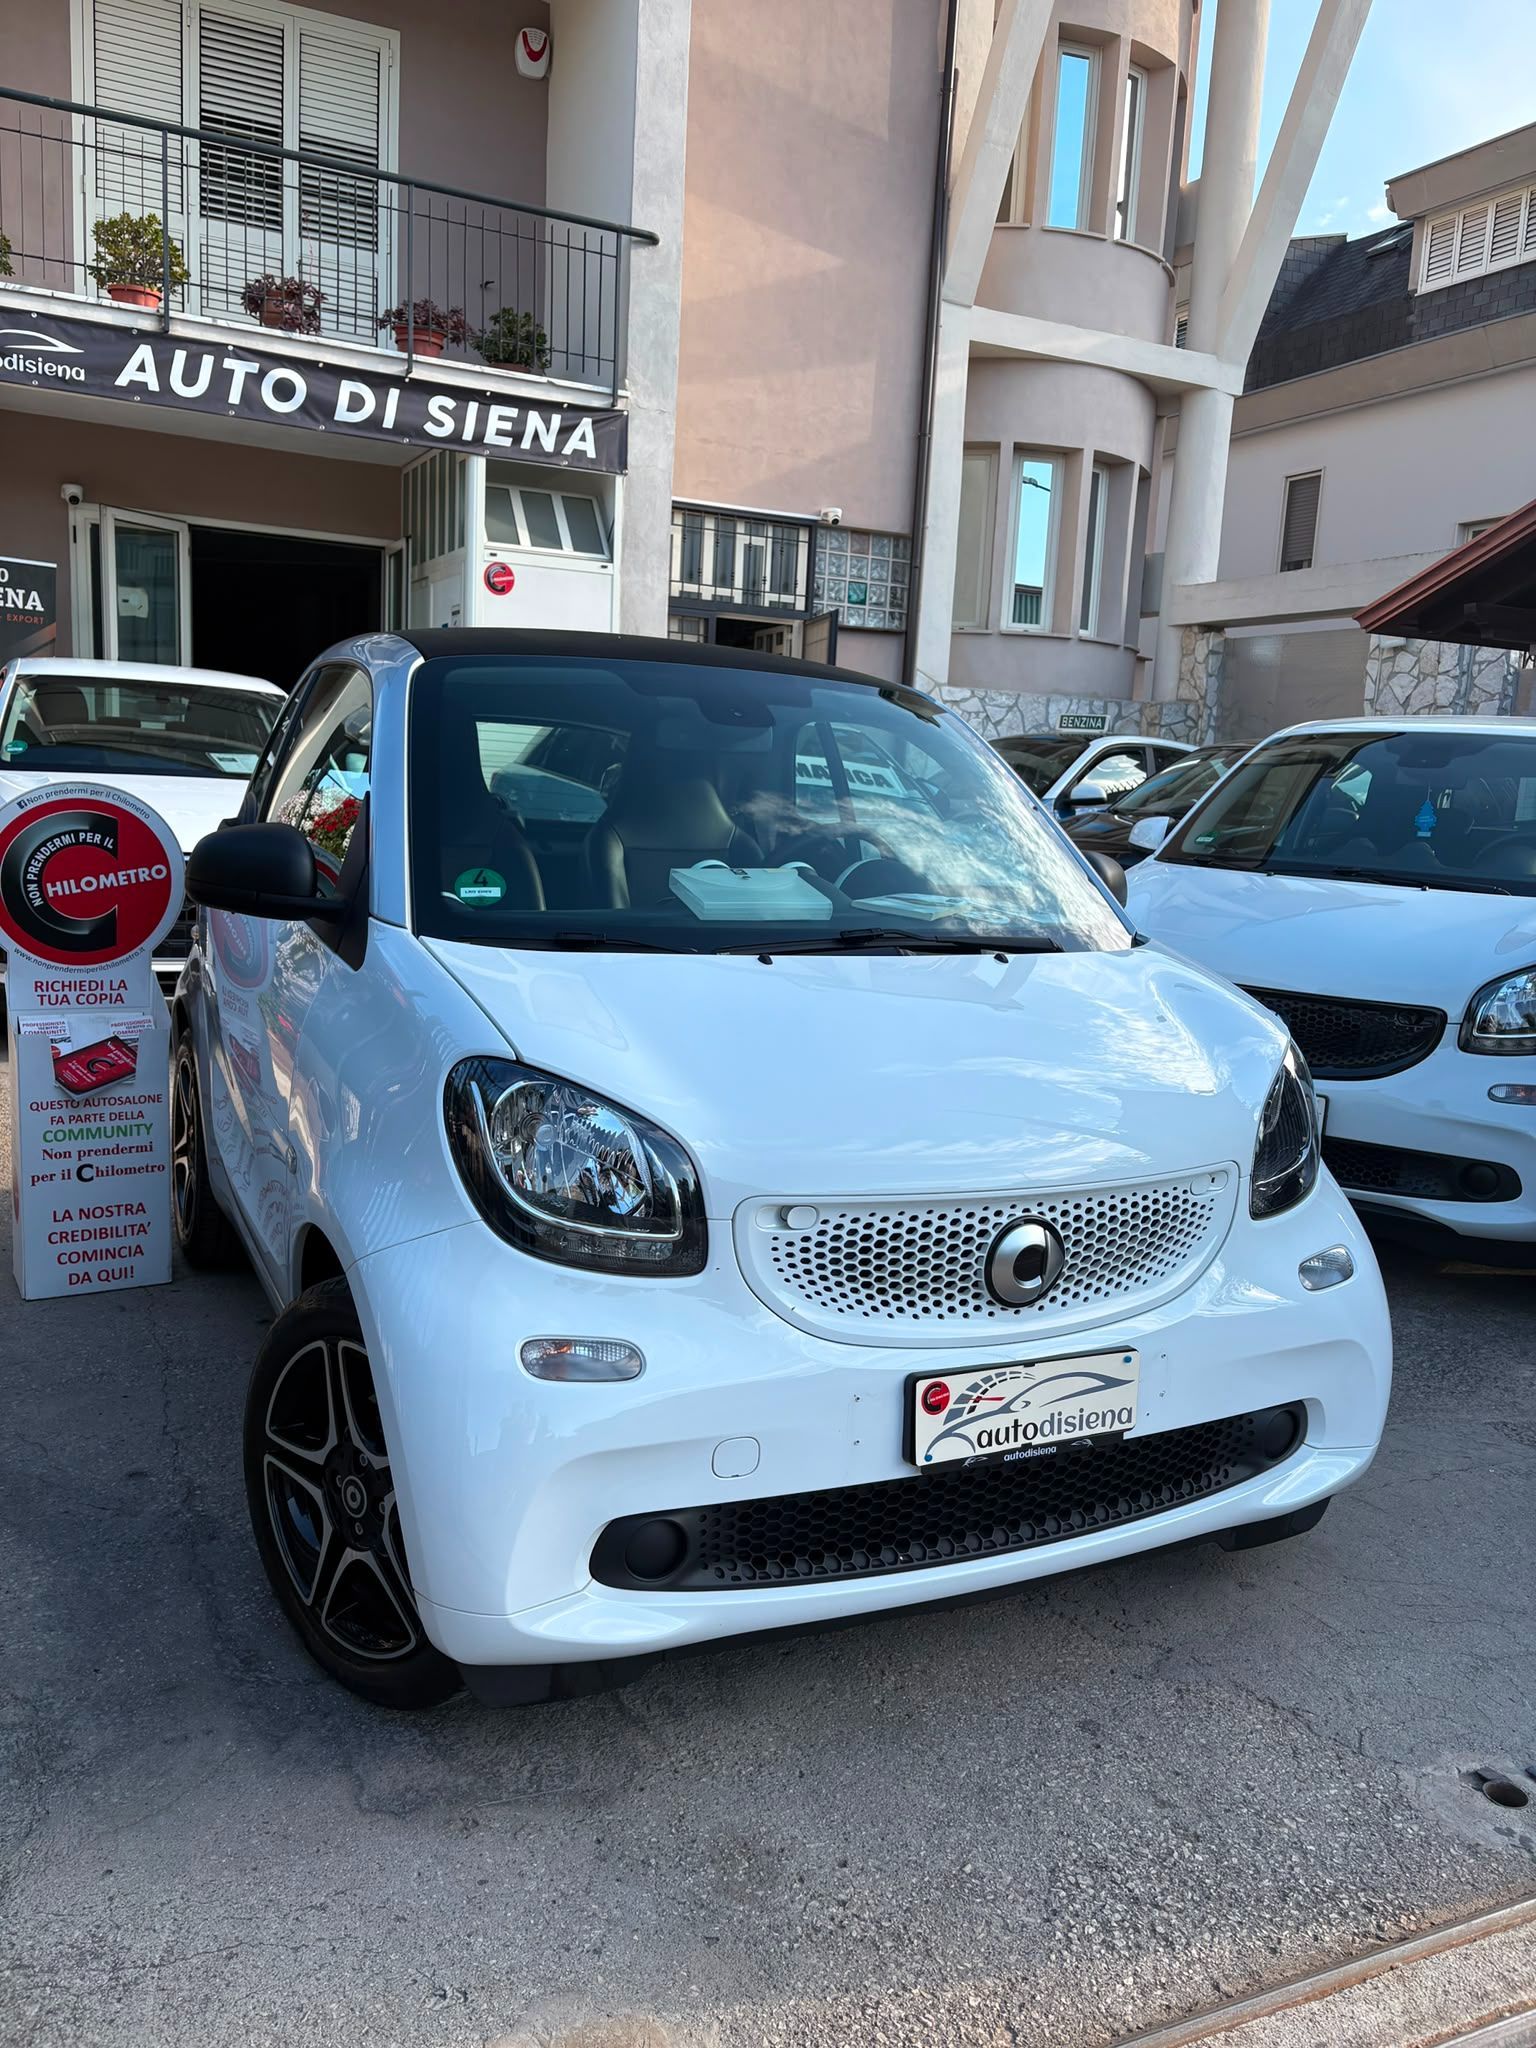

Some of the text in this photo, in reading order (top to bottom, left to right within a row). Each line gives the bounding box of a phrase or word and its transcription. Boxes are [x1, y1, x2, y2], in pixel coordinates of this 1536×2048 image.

[0, 353, 86, 382] disiena
[114, 344, 597, 459] AUTO DI SIENA
[6, 614, 44, 624] EXPORT
[1061, 716, 1102, 728] BENZINA
[27, 787, 151, 820] Non prendermi per il Chilometro
[27, 831, 114, 907] NON PRENDERMI PER IL
[473, 870, 488, 887] 4
[14, 946, 146, 975] www.nonprendermiperilchilometro.it
[34, 979, 128, 993] RICHIEDI LA
[37, 993, 125, 1006] TUA COPIA
[30, 1094, 163, 1112] QUESTO AUTOSALONE
[50, 1110, 145, 1125] FA PARTE DELLA
[42, 1124, 153, 1143] COMMUNITY
[42, 1142, 153, 1161] Non prendermi
[31, 1163, 165, 1186] per il Chilometro
[53, 1202, 147, 1223] LA NOSTRA
[48, 1222, 151, 1245] CREDIBILITA'
[57, 1244, 144, 1265] COMINCIA
[68, 1265, 135, 1285] DA QUI!
[977, 1405, 1133, 1449] autodisiena
[1003, 1445, 1057, 1462] autodisiena
